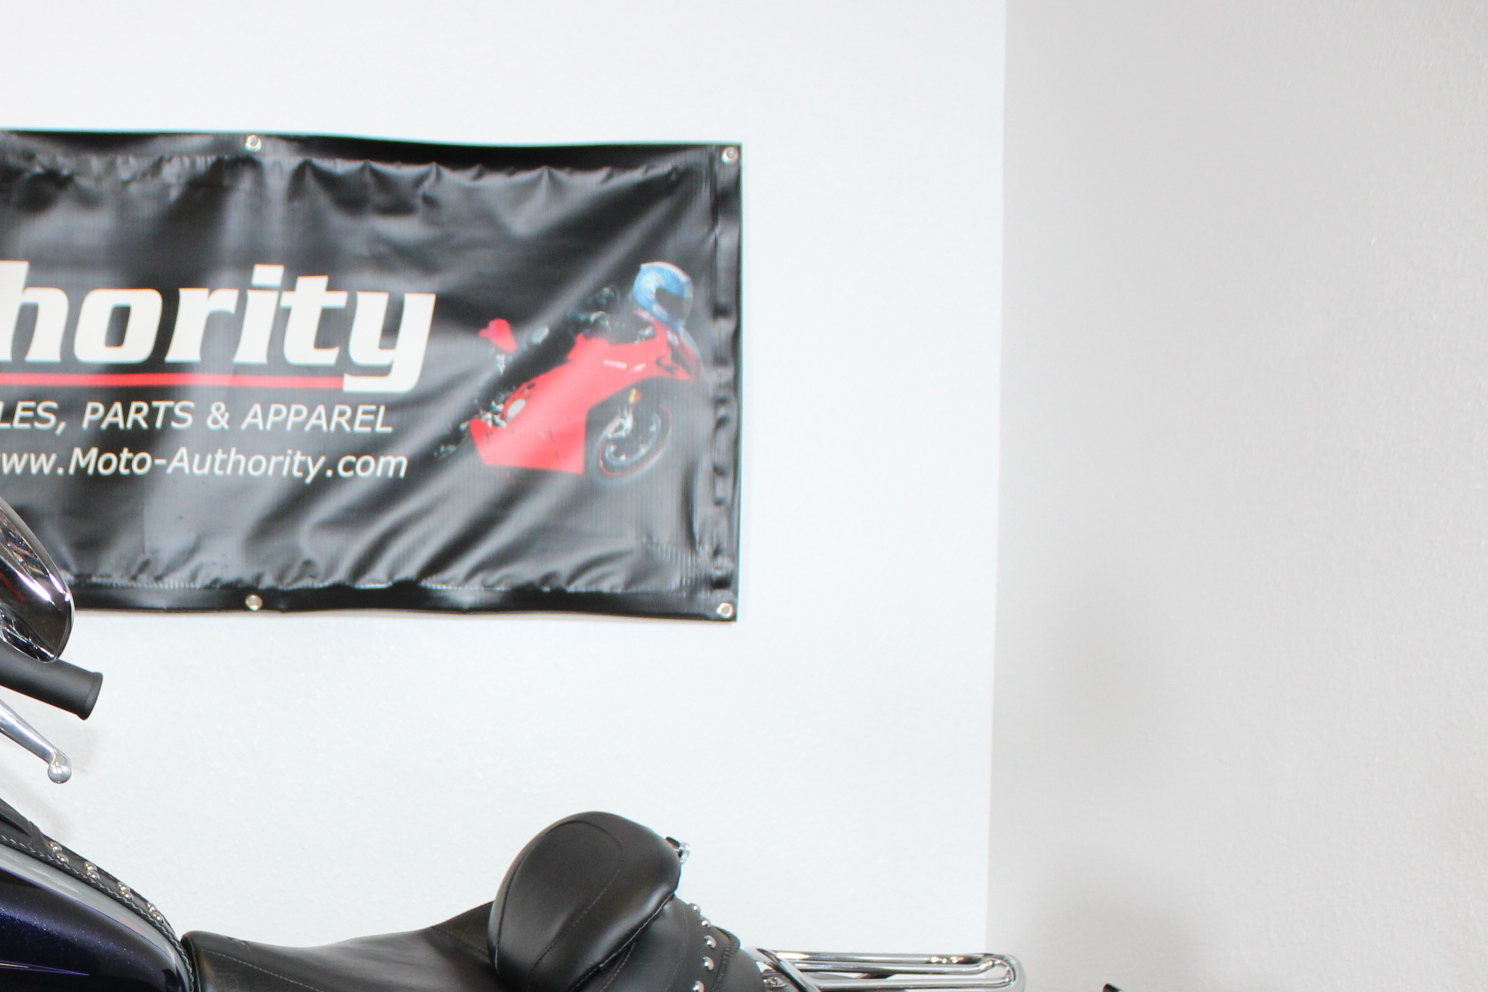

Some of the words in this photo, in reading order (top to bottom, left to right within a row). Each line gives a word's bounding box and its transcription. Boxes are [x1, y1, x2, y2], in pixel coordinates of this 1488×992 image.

[81, 401, 194, 430] PARTS
[205, 400, 232, 432] &
[240, 402, 393, 433] APPAREL
